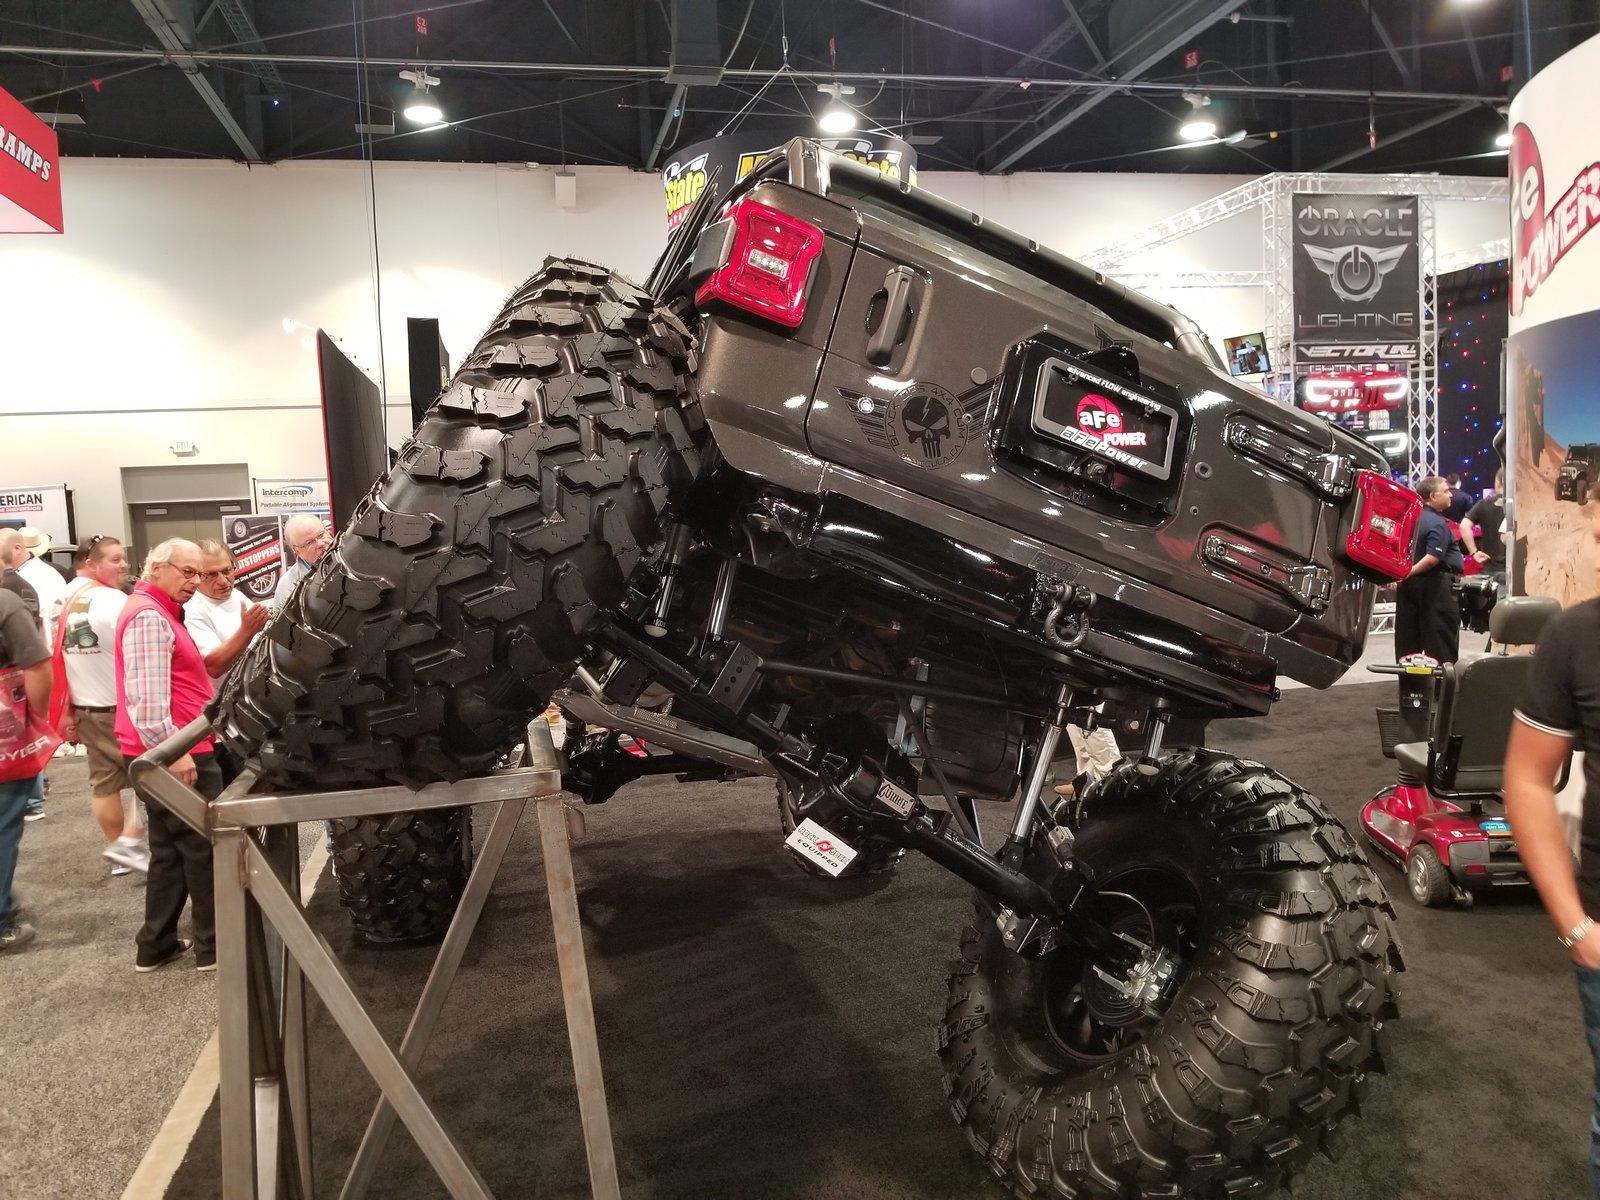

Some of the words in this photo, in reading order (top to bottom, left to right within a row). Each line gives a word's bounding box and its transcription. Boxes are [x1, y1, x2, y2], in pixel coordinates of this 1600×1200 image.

[1299, 205, 1412, 236] ORACLE
[1299, 312, 1413, 328] LIGHTING
[1066, 366, 1102, 385] advanced
[1101, 379, 1121, 394] FLOW
[1120, 390, 1162, 411] engineering
[1079, 410, 1120, 428] aFe
[1103, 431, 1147, 446] POWER
[262, 489, 308, 497] Intercomp
[797, 838, 839, 868] EQUIPPED
